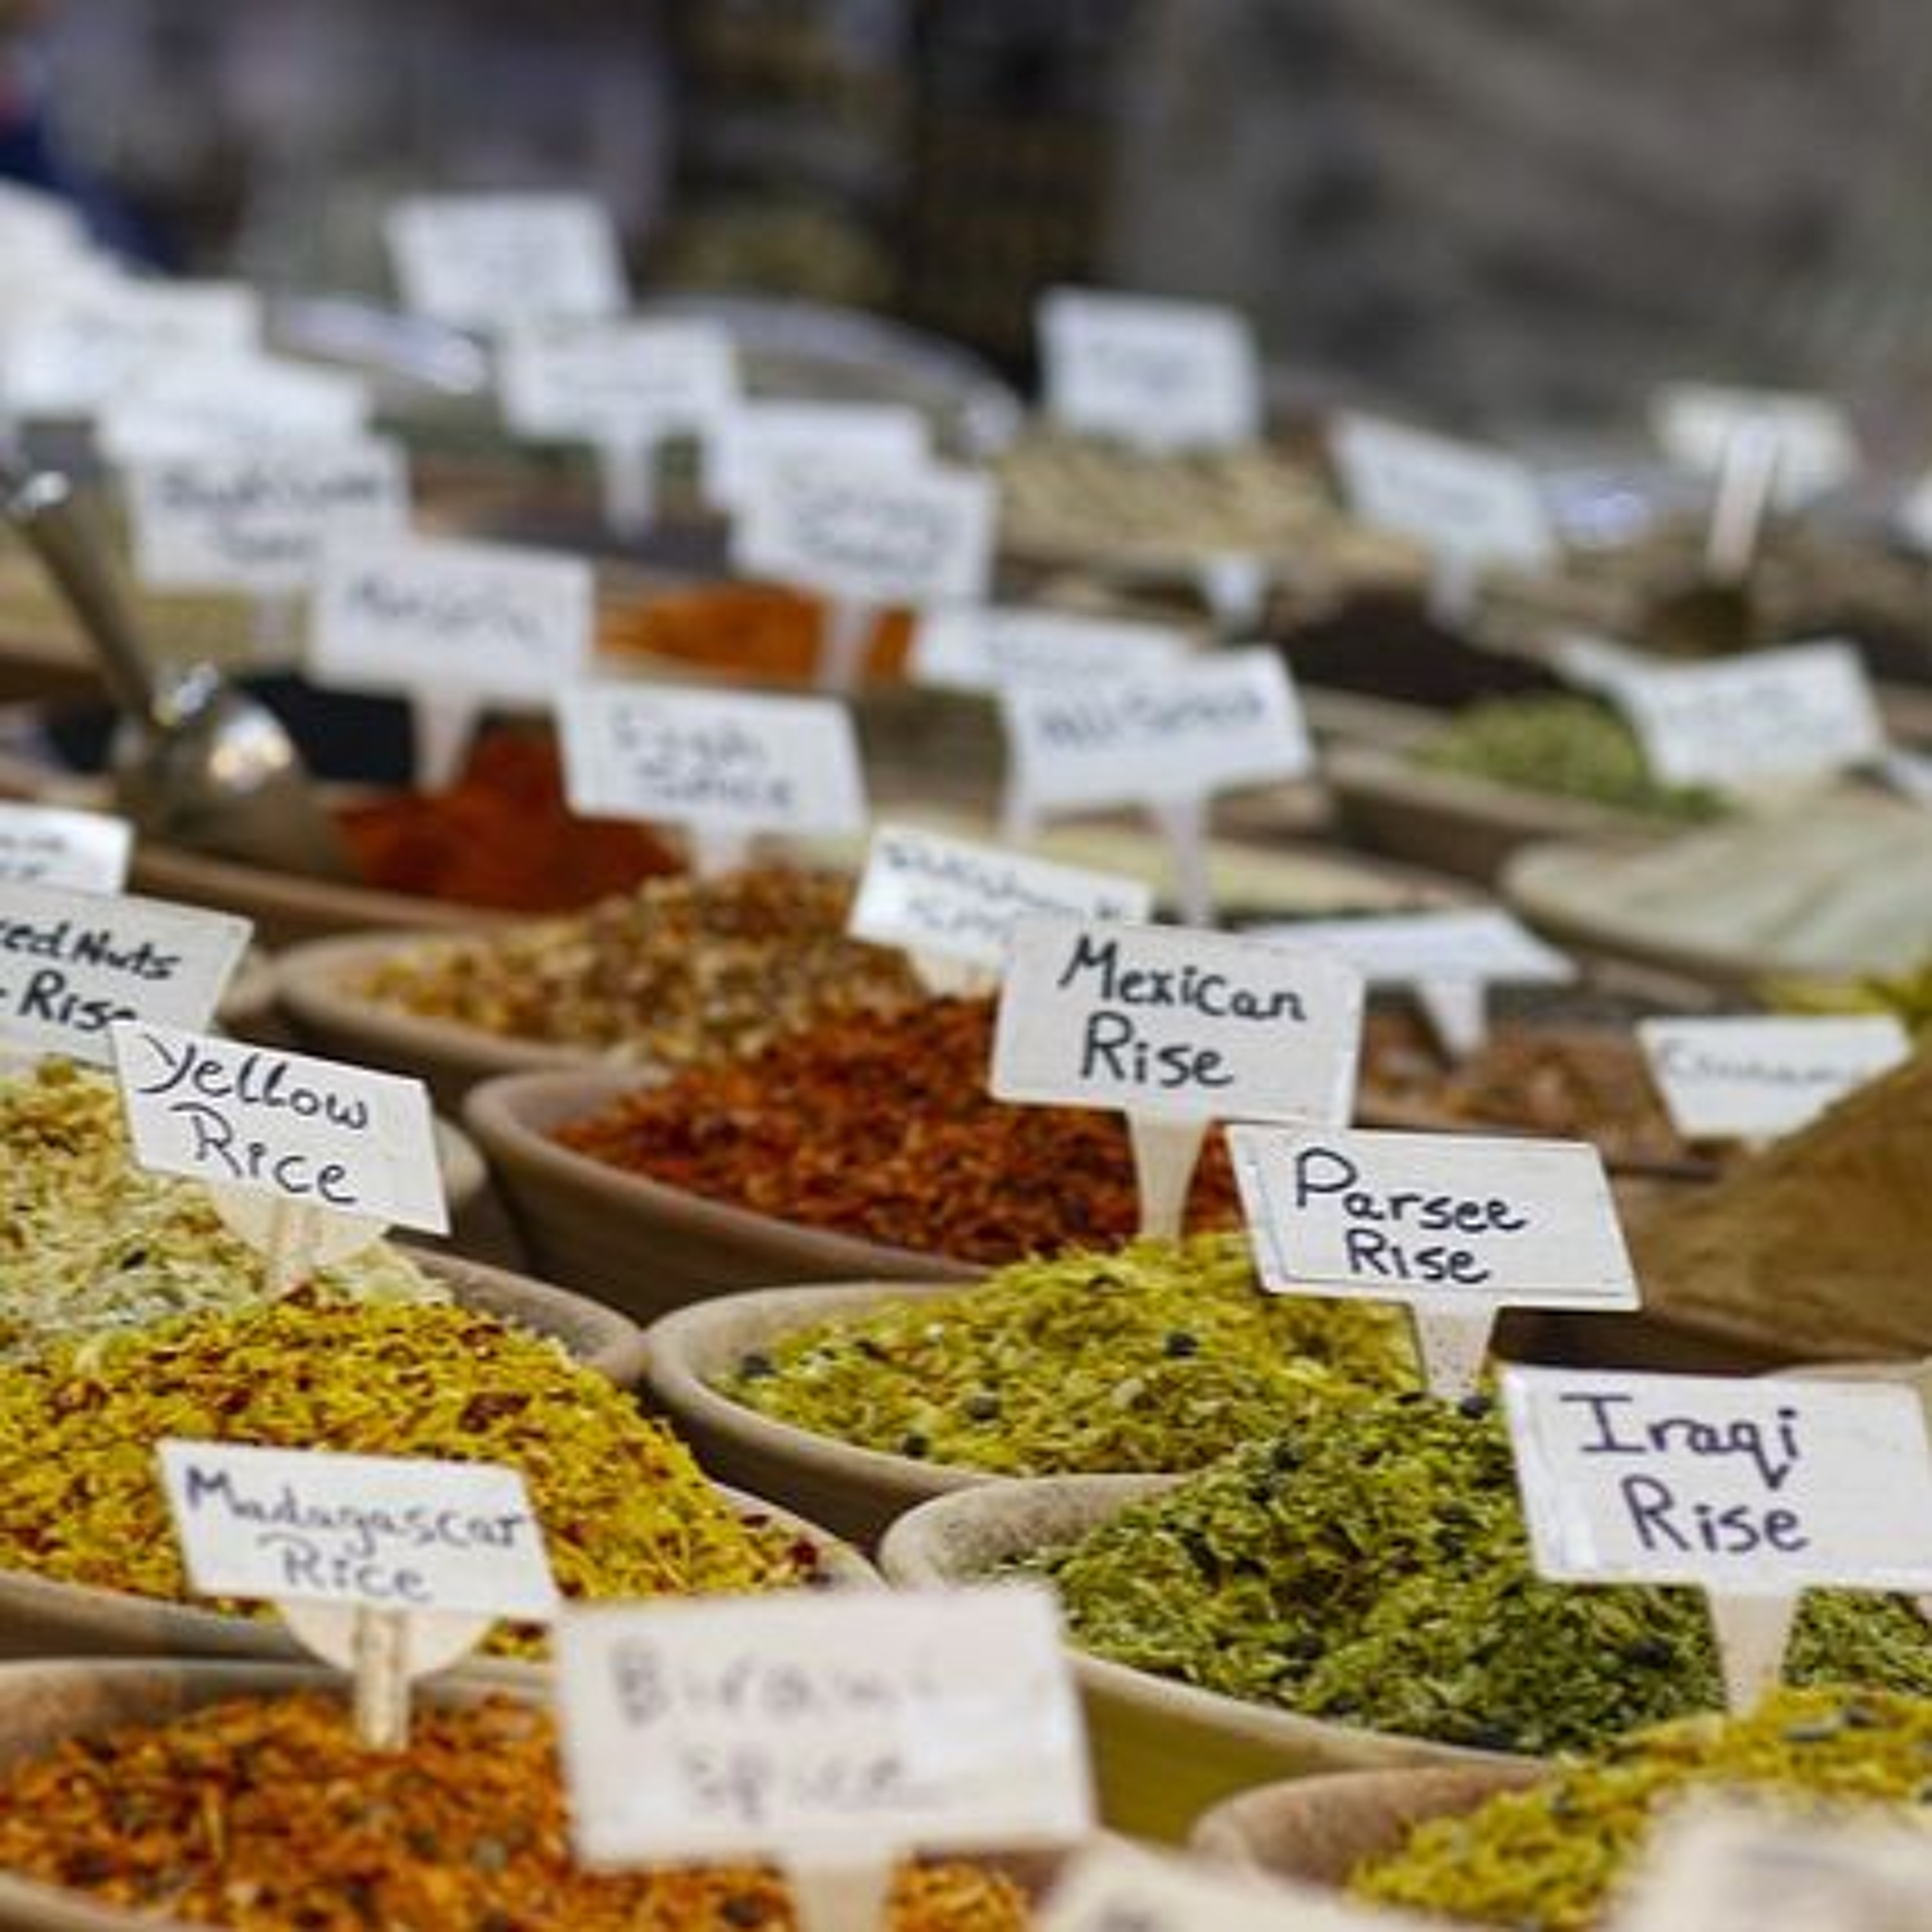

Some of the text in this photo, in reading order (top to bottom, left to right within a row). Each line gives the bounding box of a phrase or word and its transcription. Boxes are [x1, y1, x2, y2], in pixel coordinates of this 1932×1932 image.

[72, 929, 182, 980] Nuts
[1057, 933, 1306, 1021] Mexican
[137, 1033, 368, 1131] Yellow
[1079, 1010, 1234, 1088] Rise
[167, 1101, 358, 1204] Rice
[1296, 1146, 1528, 1233] Parsee
[1345, 1227, 1490, 1283] Rise
[1558, 1391, 1799, 1491] Iraqi
[184, 1464, 524, 1558] Madagascar
[1620, 1473, 1810, 1553] Rise
[254, 1529, 433, 1603] Rice
